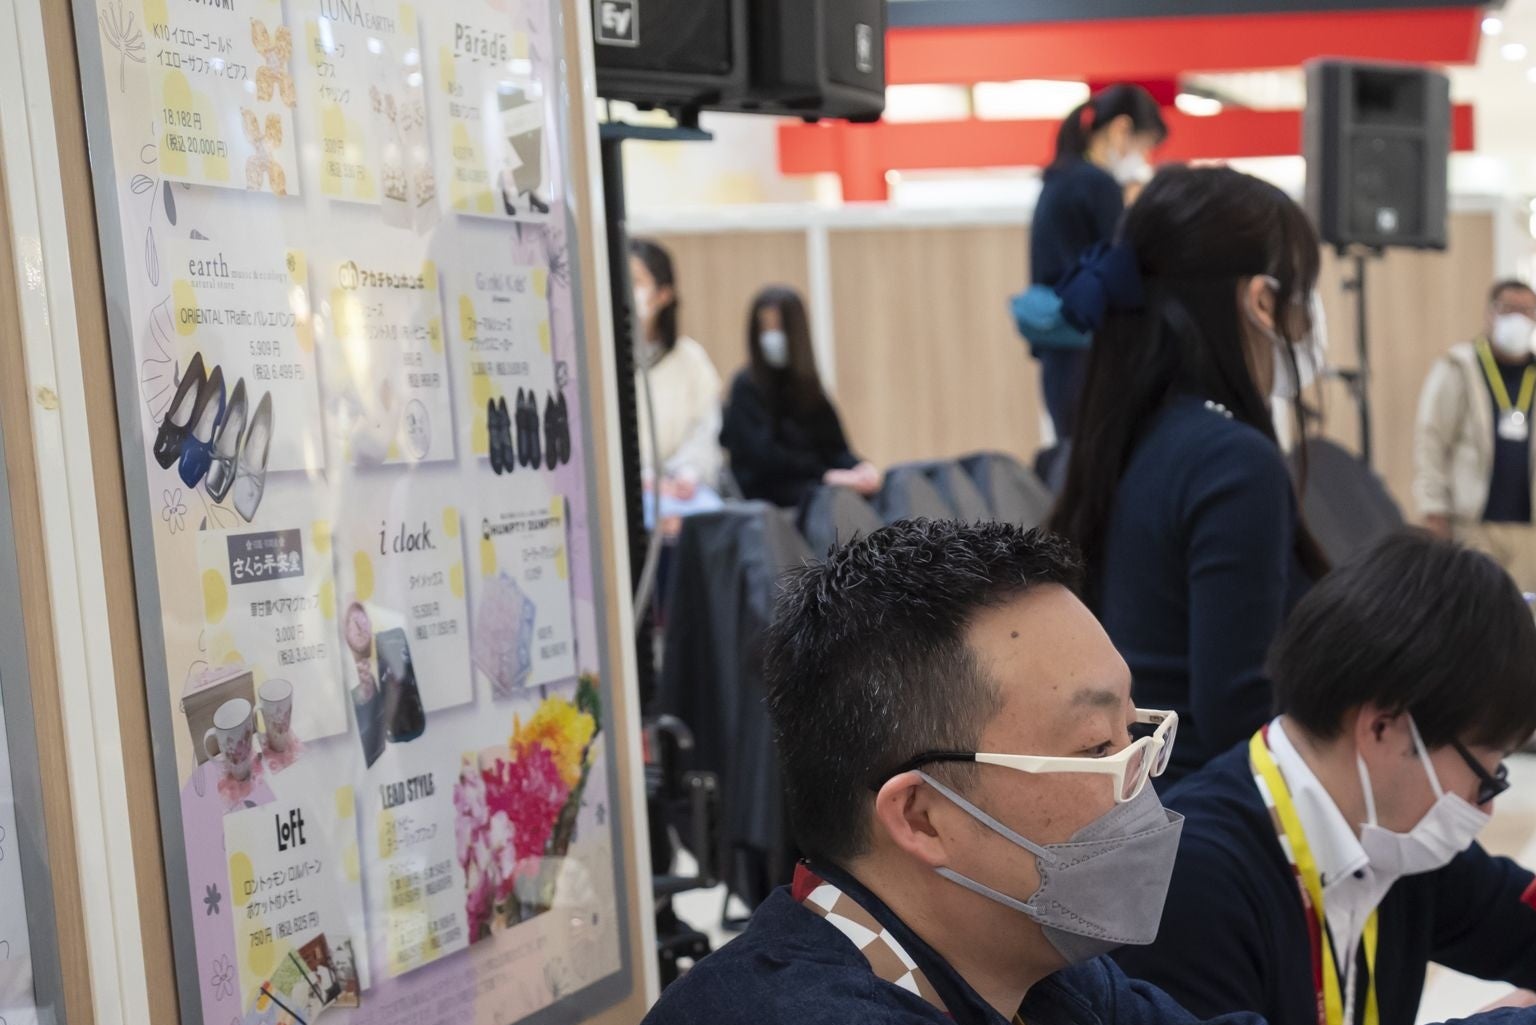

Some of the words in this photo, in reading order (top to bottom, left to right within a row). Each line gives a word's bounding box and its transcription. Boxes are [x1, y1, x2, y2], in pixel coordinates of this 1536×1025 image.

[189, 253, 229, 277] earth
[180, 307, 223, 325] ORIENTAL
[380, 781, 406, 810] LEAD
[406, 772, 435, 803] STYLE
